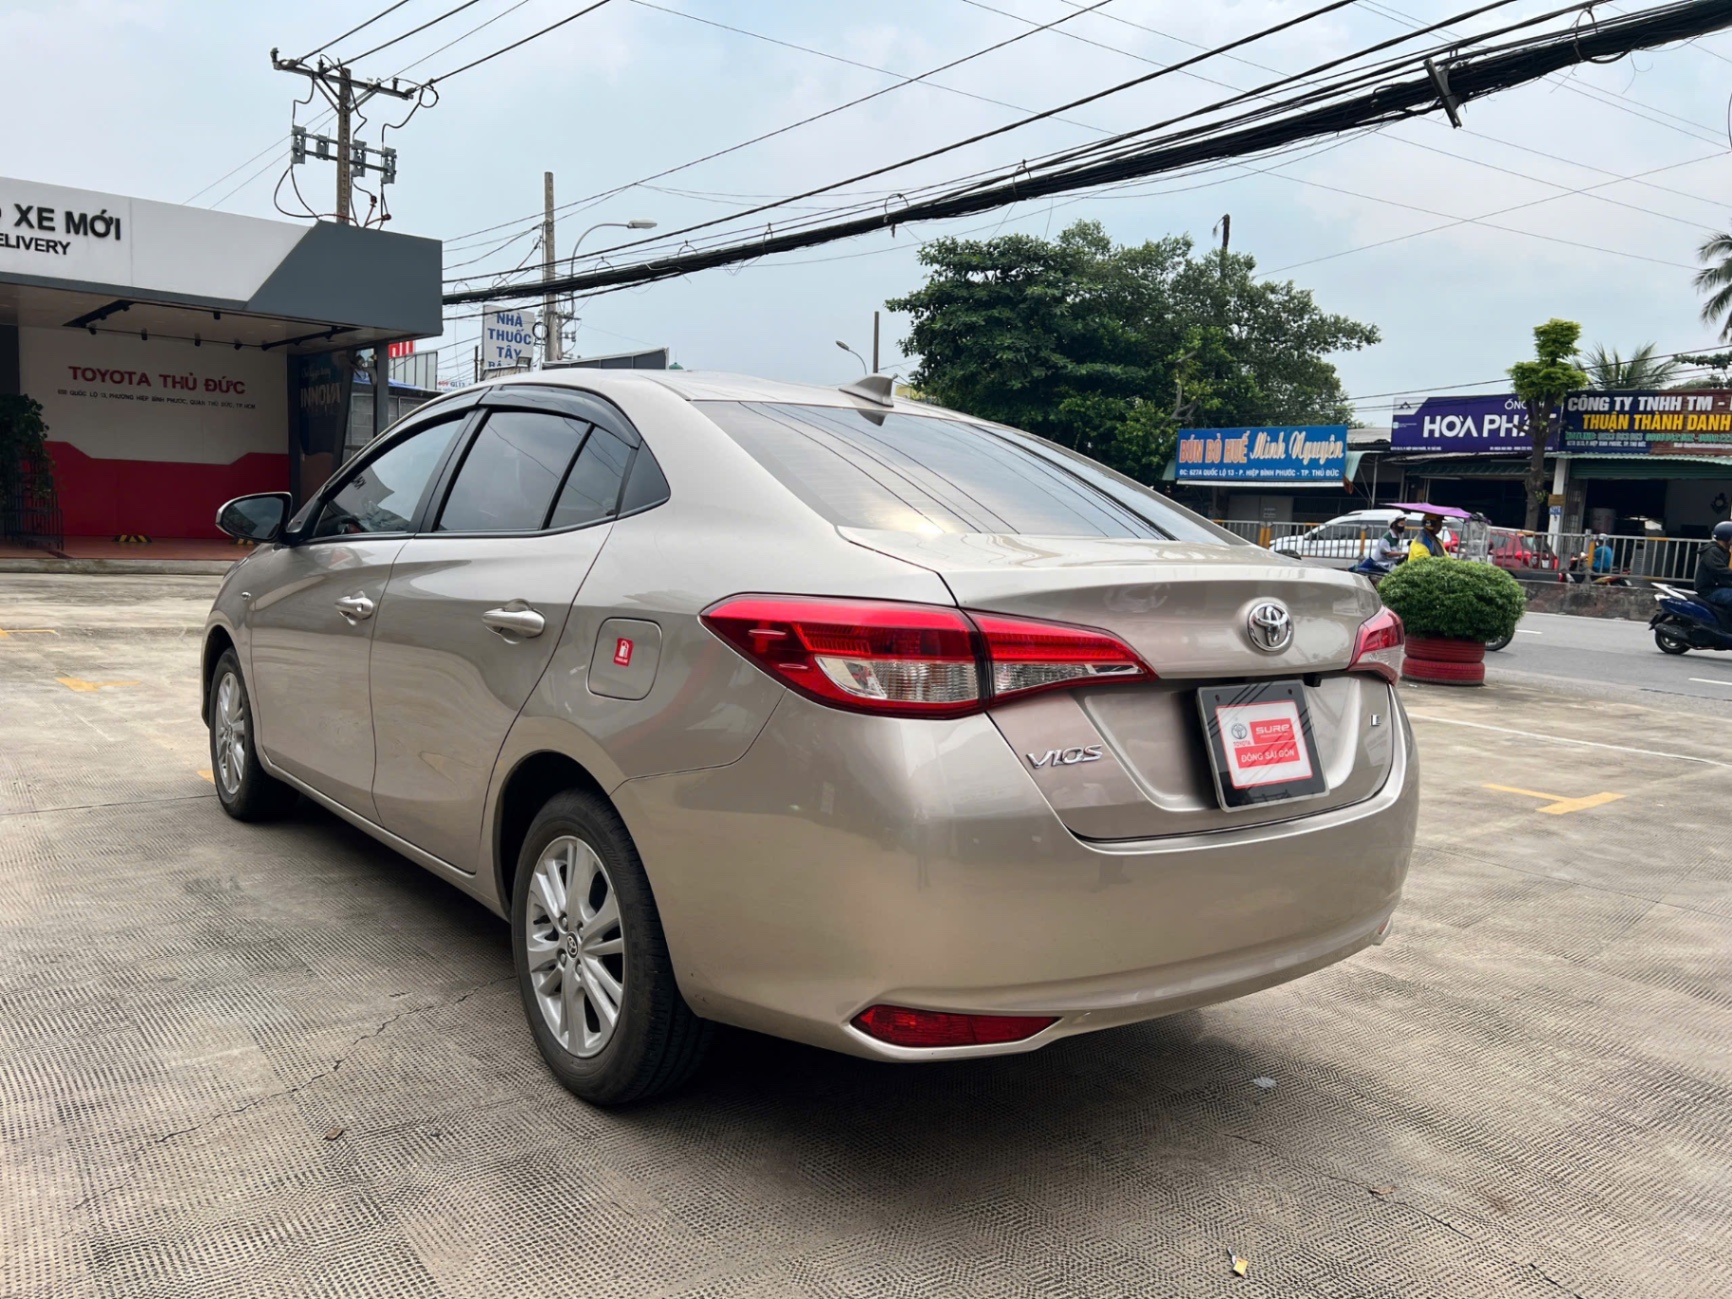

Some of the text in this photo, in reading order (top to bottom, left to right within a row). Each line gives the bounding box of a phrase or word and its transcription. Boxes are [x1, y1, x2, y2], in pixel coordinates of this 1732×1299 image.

[14, 203, 121, 241] XE MỚI
[497, 312, 523, 328] NHÀ
[487, 328, 532, 346] THUỐC
[496, 345, 522, 360] TÂY
[68, 366, 246, 395] TOYOTA THỦ ĐỨC
[1567, 394, 1610, 411] CÔNG
[1613, 396, 1633, 411] TY
[1638, 396, 1682, 411] TNHH
[1686, 396, 1713, 411] TM
[1482, 414, 1557, 438] PH
[1583, 411, 1731, 433] THUẬN THÀNH DANH
[1179, 430, 1344, 465] BÚN BÒ HUẾ Minh Nguyên
[1203, 467, 1219, 476] QUỐC
[1219, 468, 1227, 477] LỘ
[1246, 468, 1259, 477] HIỆP
[1260, 467, 1274, 477] BÌNH
[1275, 467, 1296, 477] PHƯỚC
[1312, 467, 1325, 477] THỦ
[1325, 467, 1339, 477] ĐỨC
[1026, 744, 1103, 769] VIOS
[1241, 748, 1295, 763] ĐÔNG SÀI GÒN
